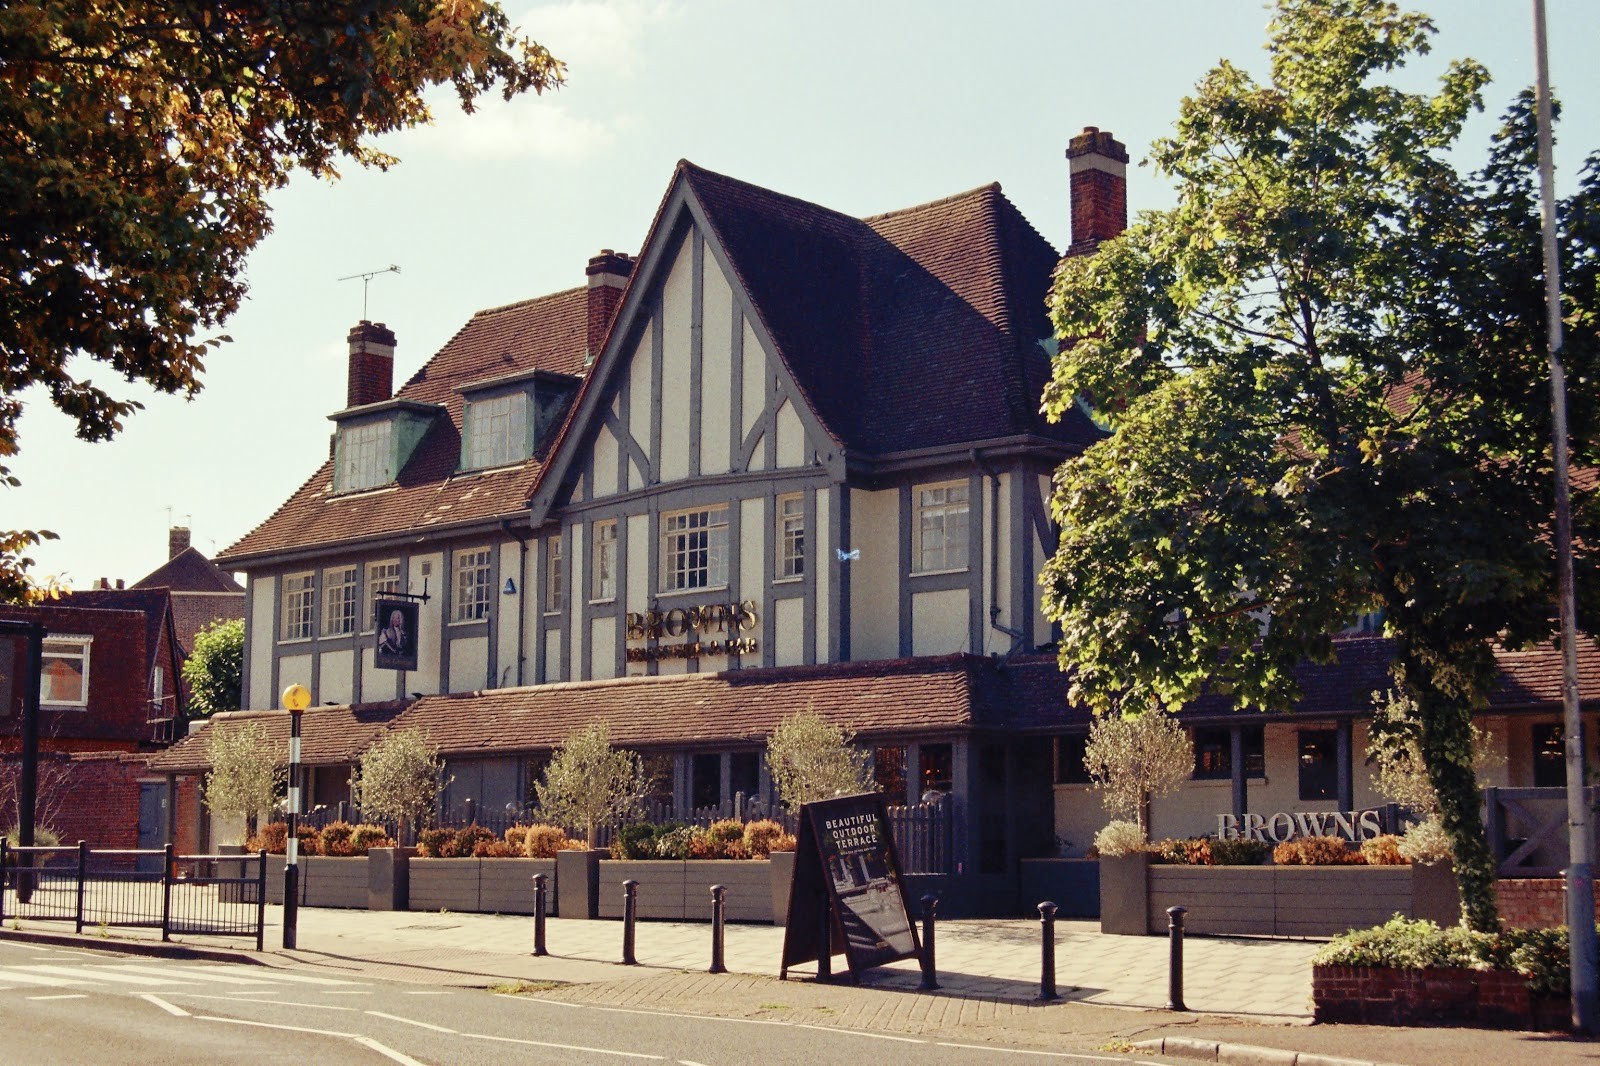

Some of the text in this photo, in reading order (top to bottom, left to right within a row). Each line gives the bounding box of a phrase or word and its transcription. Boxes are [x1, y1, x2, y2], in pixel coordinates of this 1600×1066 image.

[626, 600, 757, 640] BROWNS
[825, 813, 878, 829] BEAUTIFUL
[1215, 810, 1381, 842] BROWNS
[832, 824, 876, 839] OUTDOOR
[835, 834, 878, 849] TERRACE
